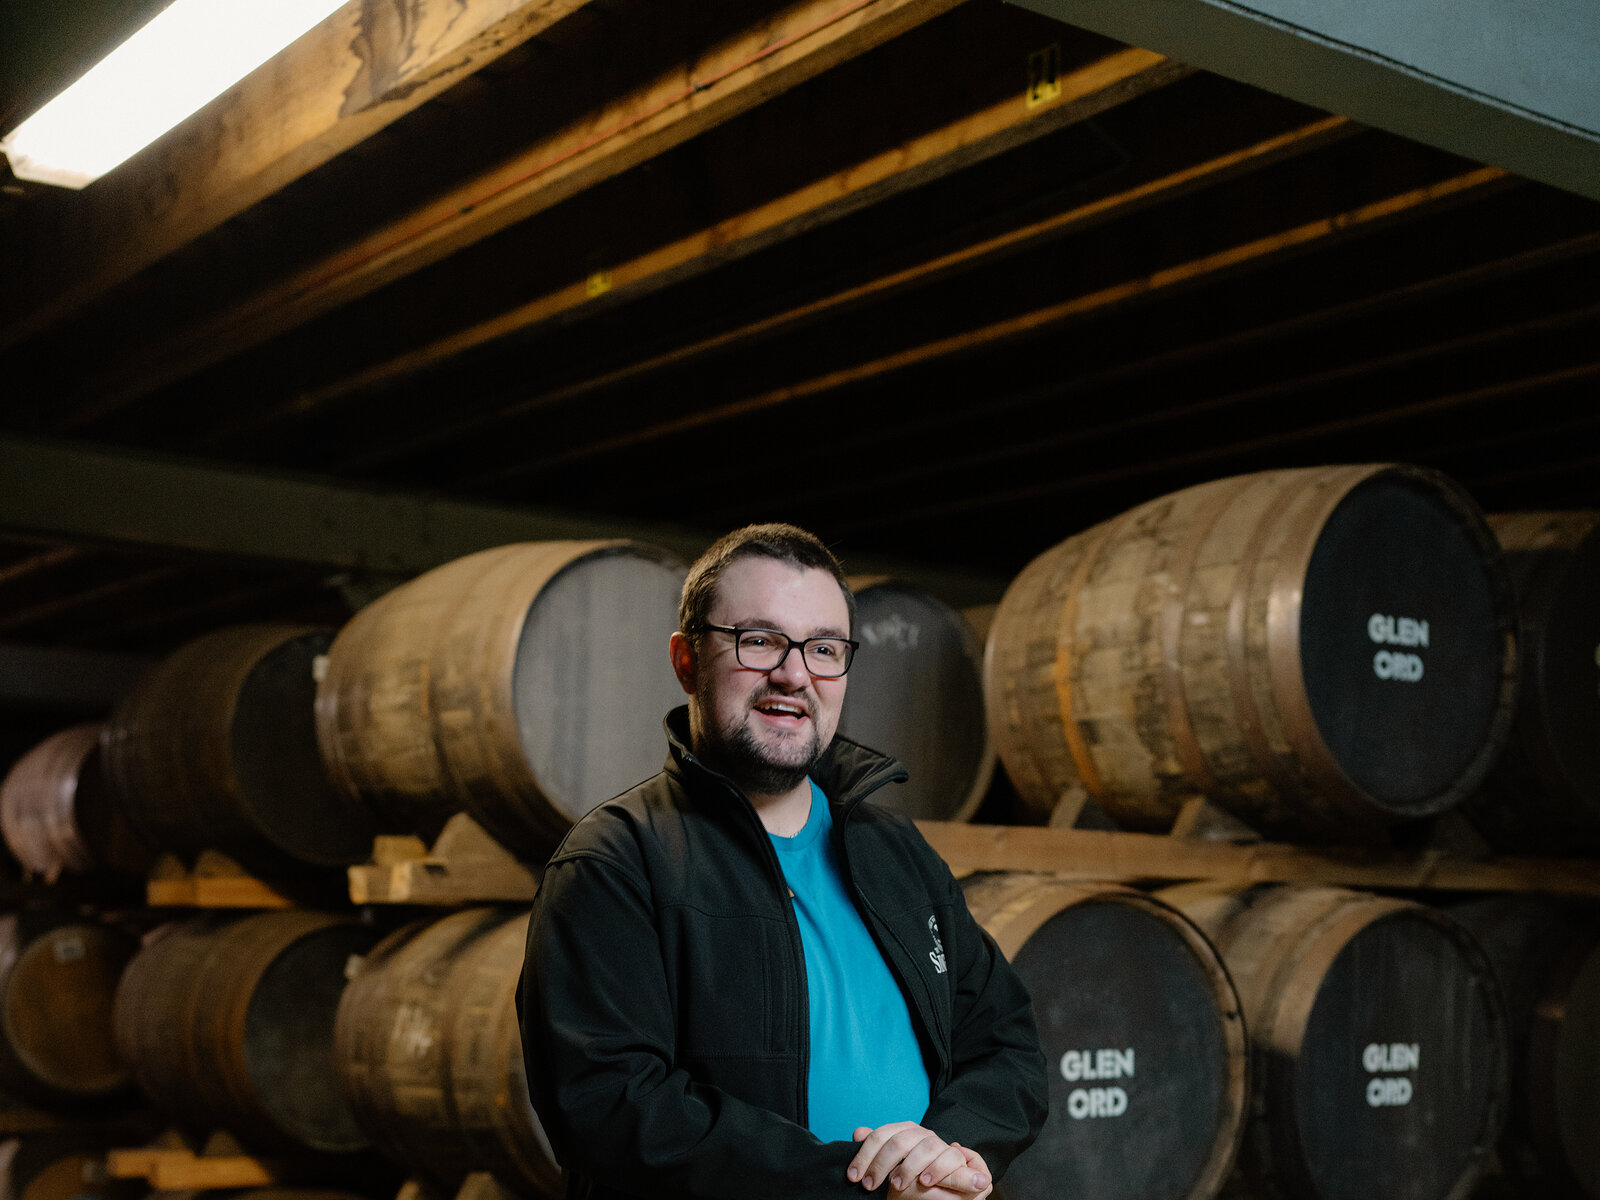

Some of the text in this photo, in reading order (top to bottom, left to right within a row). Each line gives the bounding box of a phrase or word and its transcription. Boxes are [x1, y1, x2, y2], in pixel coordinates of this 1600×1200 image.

[1367, 612, 1430, 649] GLEN
[1373, 649, 1424, 682] ORD
[1060, 1047, 1135, 1082] GLEN
[1362, 1042, 1420, 1073] GLEN
[1067, 1086, 1128, 1120] ORD
[1366, 1077, 1413, 1108] ORD
